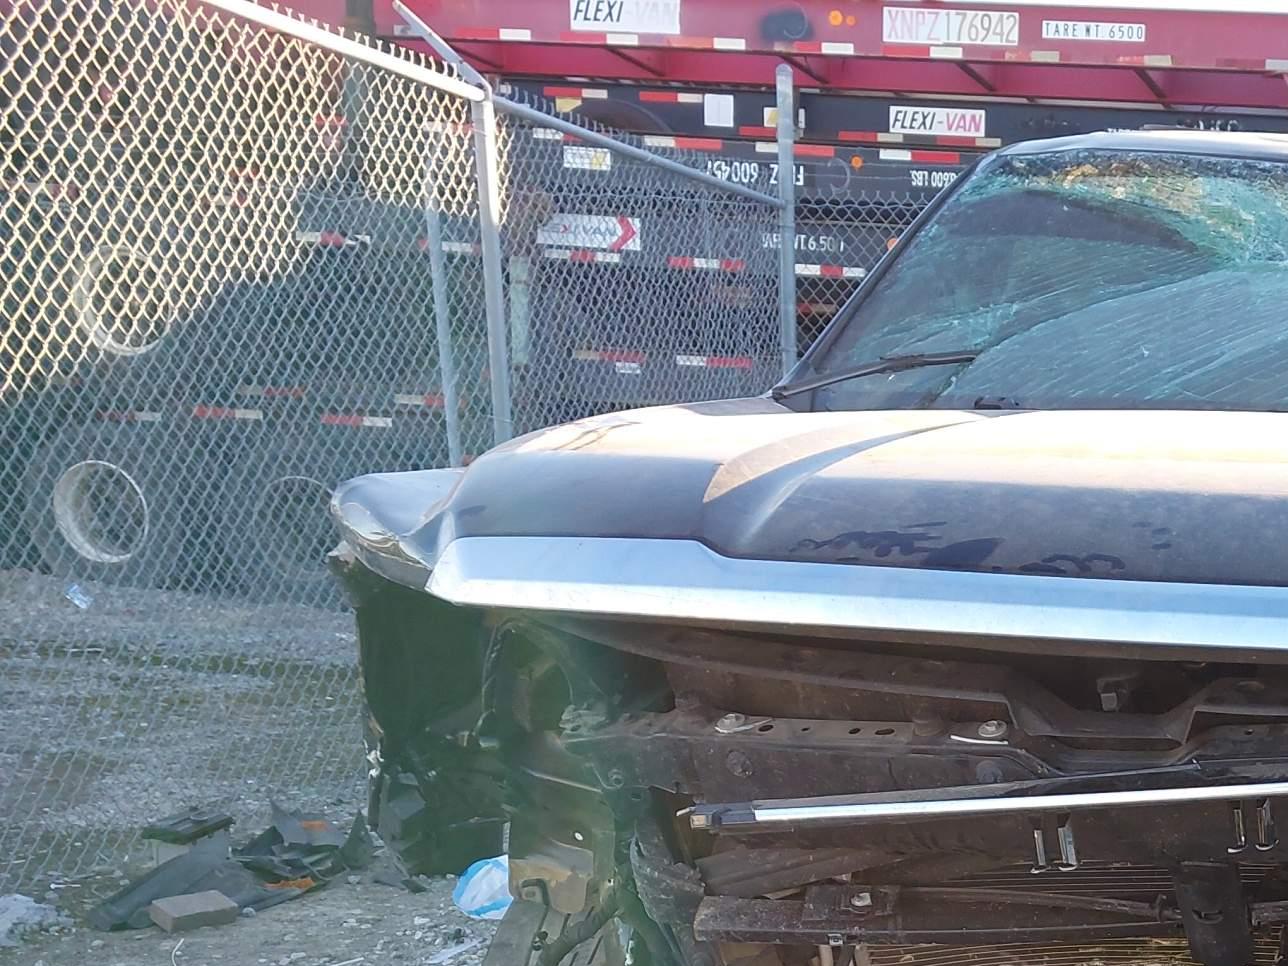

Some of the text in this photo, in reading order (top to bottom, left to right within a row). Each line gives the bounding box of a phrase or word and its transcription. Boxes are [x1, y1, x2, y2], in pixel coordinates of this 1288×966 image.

[1045, 22, 1078, 37] TARE
[1108, 25, 1143, 39] 6500
[892, 110, 982, 132] FLEXI-VAN
